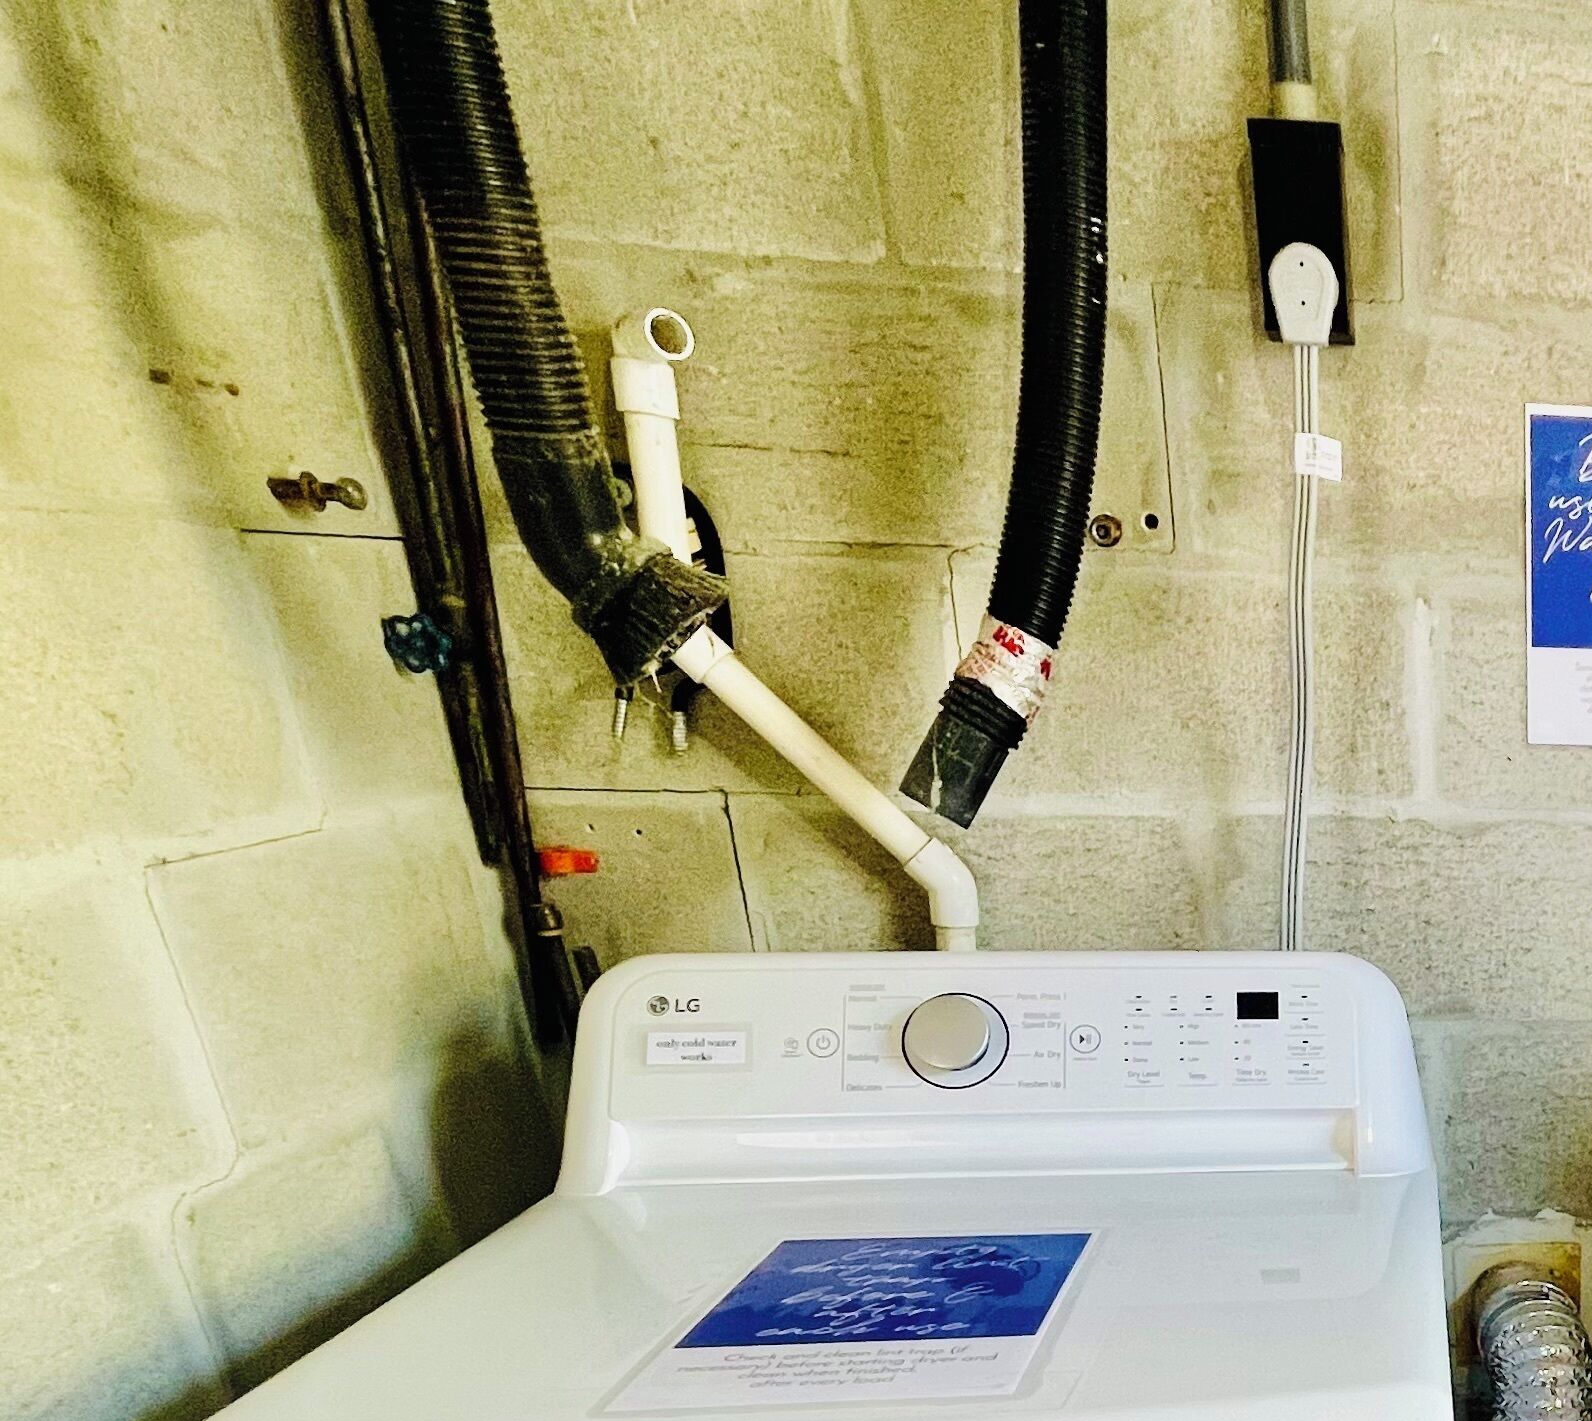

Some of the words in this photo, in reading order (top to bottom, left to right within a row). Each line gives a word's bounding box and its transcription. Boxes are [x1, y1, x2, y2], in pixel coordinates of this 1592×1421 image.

[674, 998, 701, 1013] LG
[841, 1244, 997, 1262] Empty
[790, 1259, 916, 1277] dryer
[814, 1302, 936, 1327] after
[755, 1315, 886, 1337] each
[894, 1321, 971, 1336] use
[724, 1353, 777, 1361] Check
[783, 1351, 821, 1360] and
[823, 1350, 871, 1358] clean
[776, 1361, 833, 1369] before
[839, 1358, 905, 1367] starting
[962, 1352, 998, 1361] and
[793, 1369, 840, 1377] when
[853, 1375, 896, 1384] load
